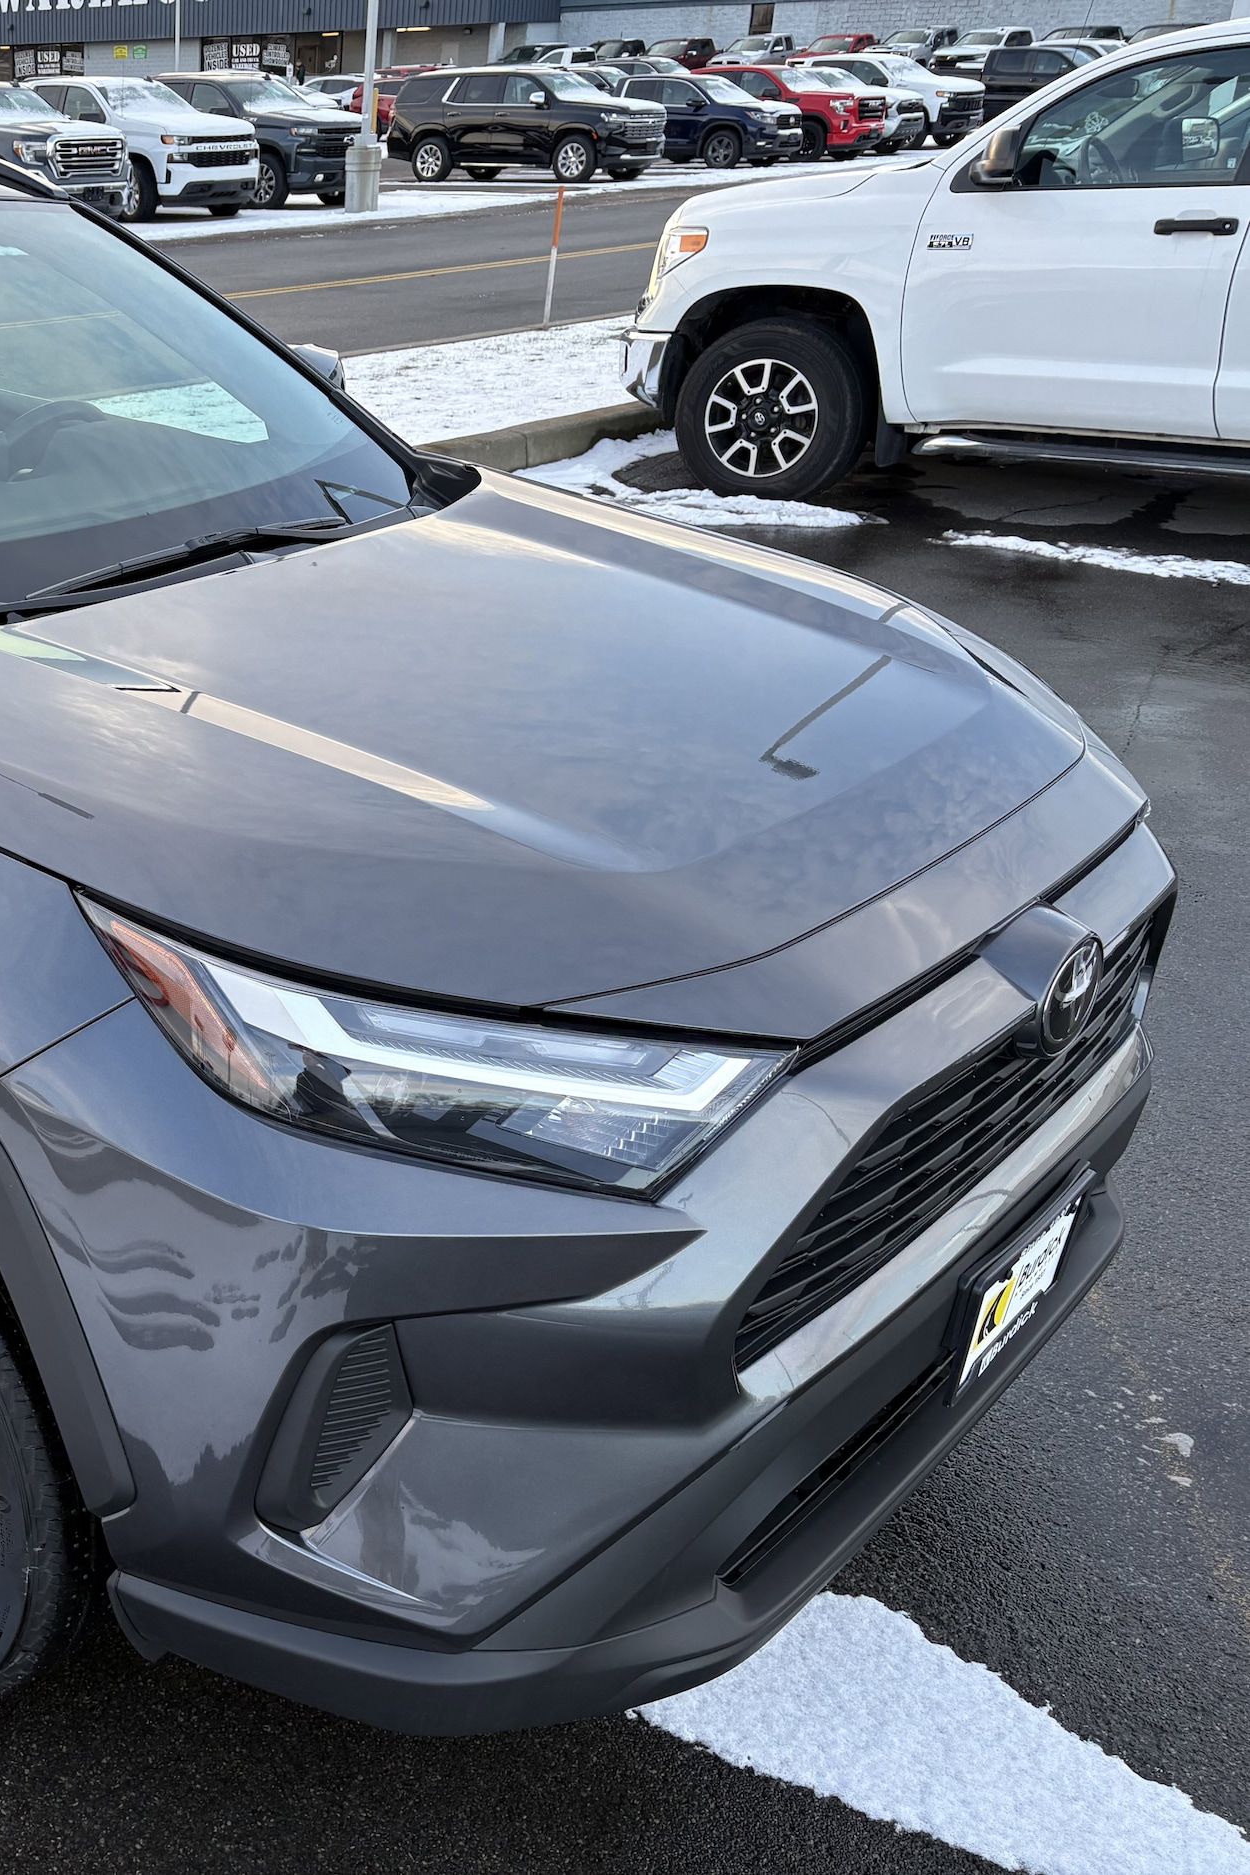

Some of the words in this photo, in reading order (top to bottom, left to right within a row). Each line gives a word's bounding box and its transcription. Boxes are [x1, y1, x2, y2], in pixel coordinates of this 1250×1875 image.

[232, 43, 260, 57] USED
[37, 51, 60, 62] USED
[16, 63, 36, 77] INSIDE
[78, 146, 107, 155] GMC
[196, 143, 253, 151] CHEVROLET
[955, 236, 970, 246] V8
[990, 1301, 1039, 1361] Burdick
